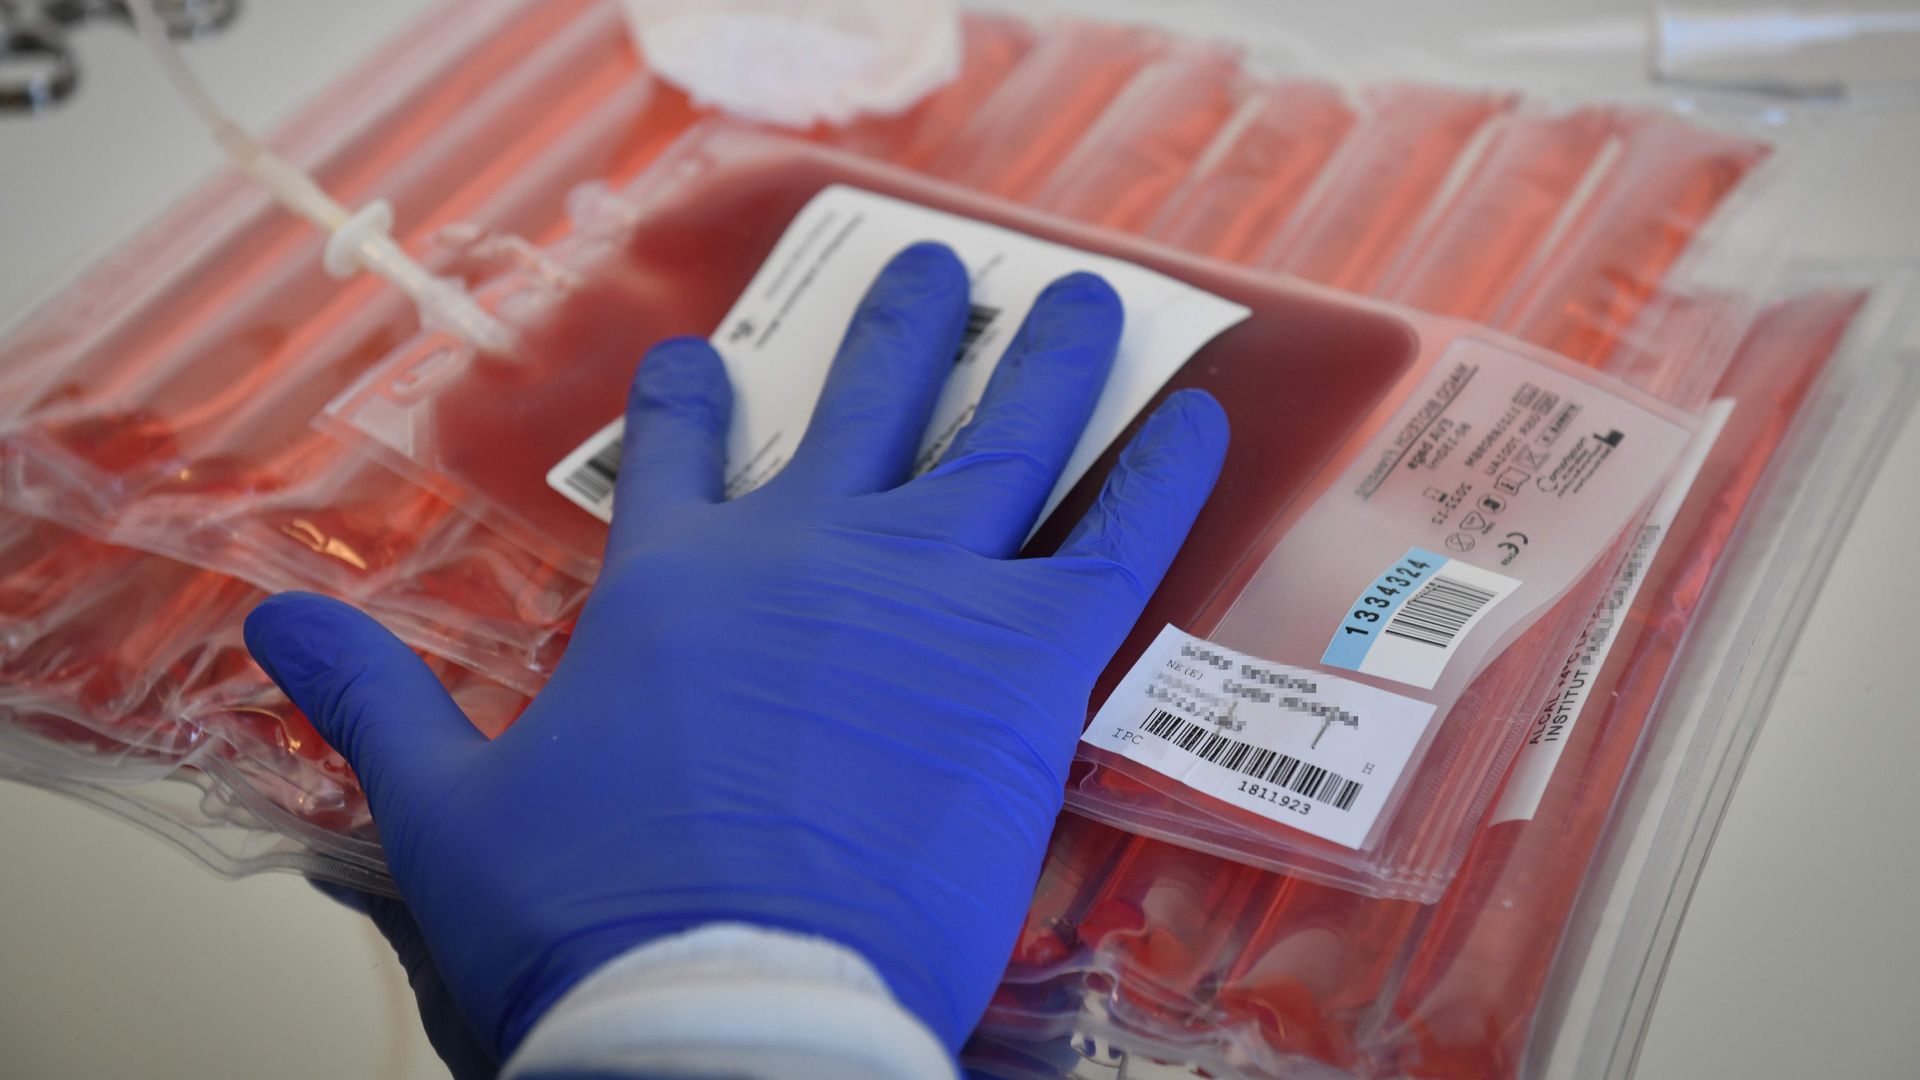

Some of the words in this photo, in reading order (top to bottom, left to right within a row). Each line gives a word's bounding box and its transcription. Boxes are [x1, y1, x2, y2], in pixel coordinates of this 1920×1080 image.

[1345, 558, 1431, 635] 1334324
[1529, 692, 1562, 744] ALCAL
[1544, 670, 1589, 741] INSTITUT
[1112, 727, 1143, 745] IPC
[1237, 780, 1312, 816] 1811923
